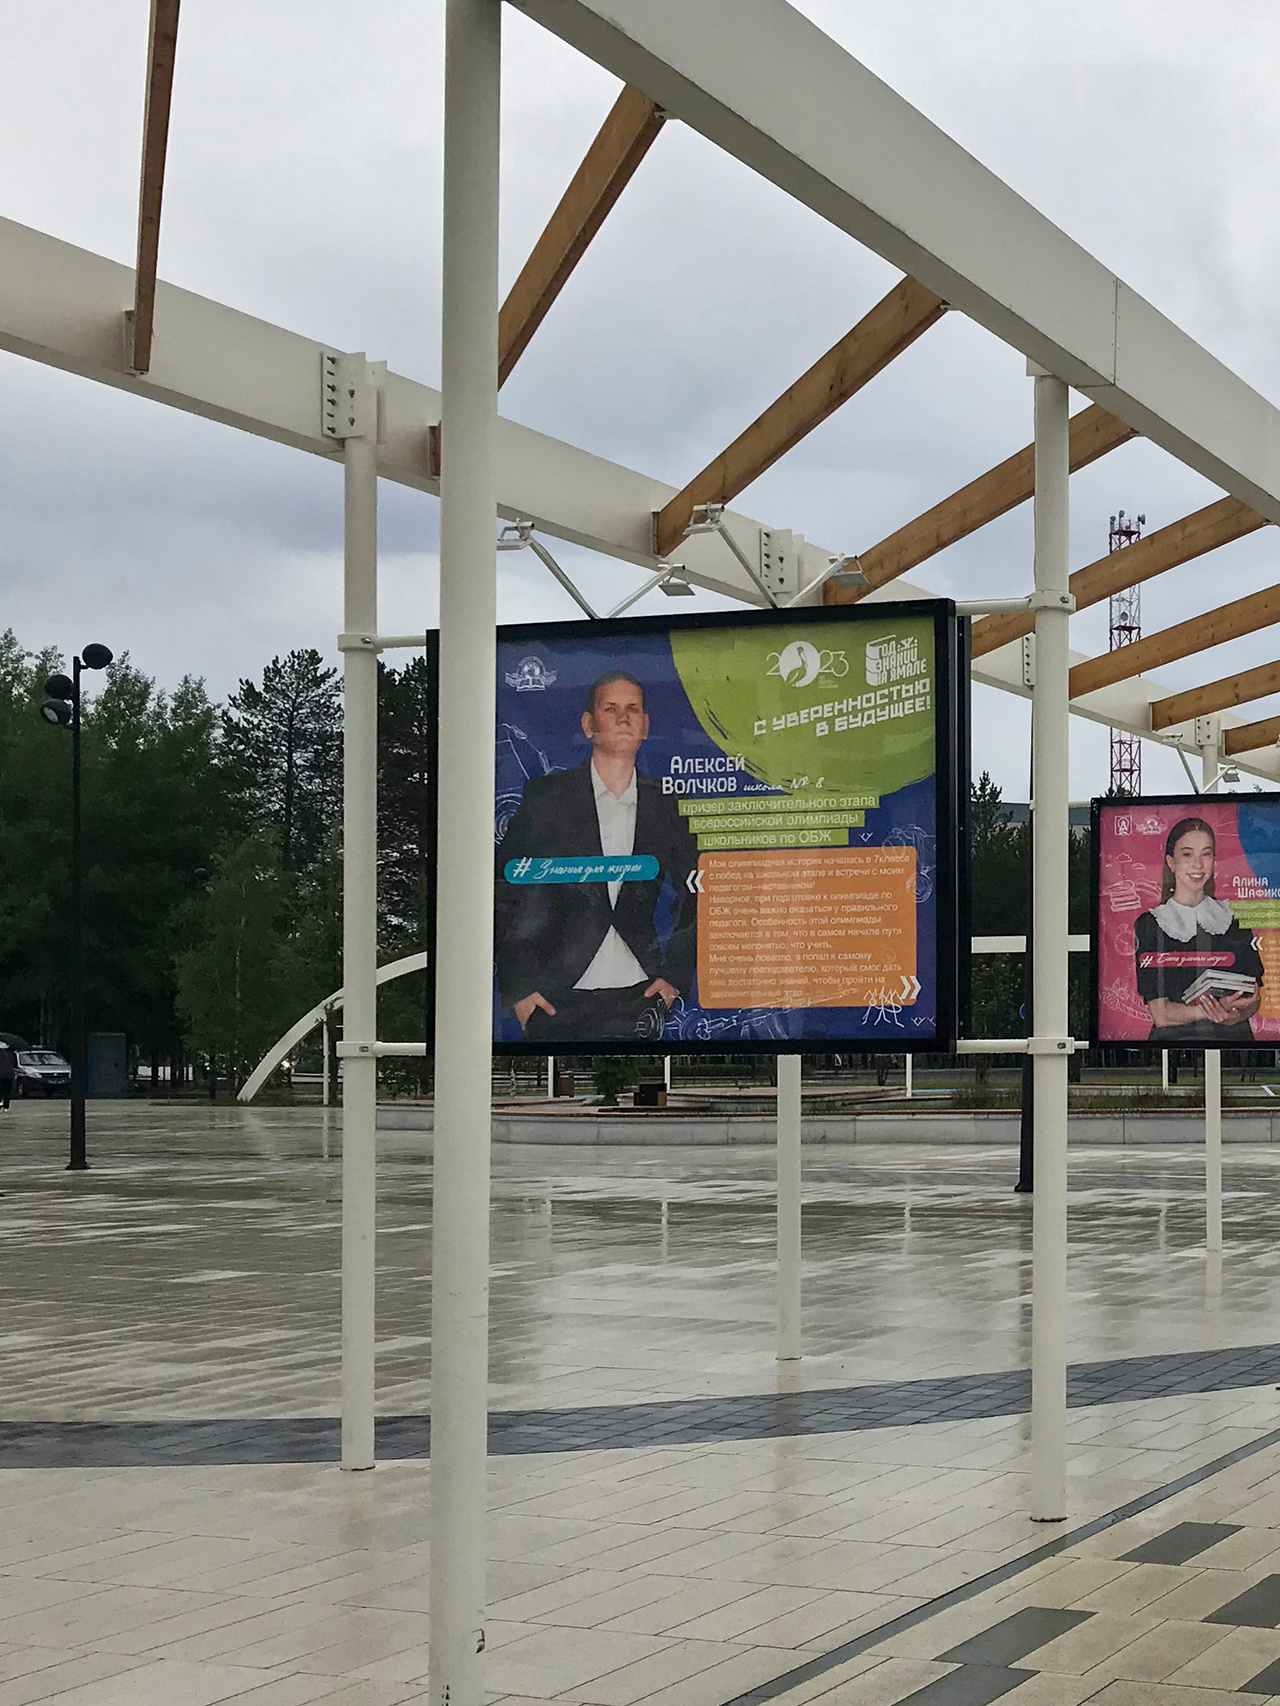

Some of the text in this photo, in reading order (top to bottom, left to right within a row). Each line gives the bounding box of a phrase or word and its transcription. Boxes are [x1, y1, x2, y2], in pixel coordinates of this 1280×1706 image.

[753, 719, 767, 736] С
[772, 677, 931, 731] УВЕРЕННОСТЬЮ
[816, 695, 931, 737] В БУДУЩЕЕ!
[815, 776, 825, 789] 8
[682, 796, 876, 816] призер заключительного этапа
[693, 813, 859, 831] всероссийской олимпиады
[703, 830, 832, 847] школьников по ОБЖ
[709, 906, 732, 916] ОБЖ
